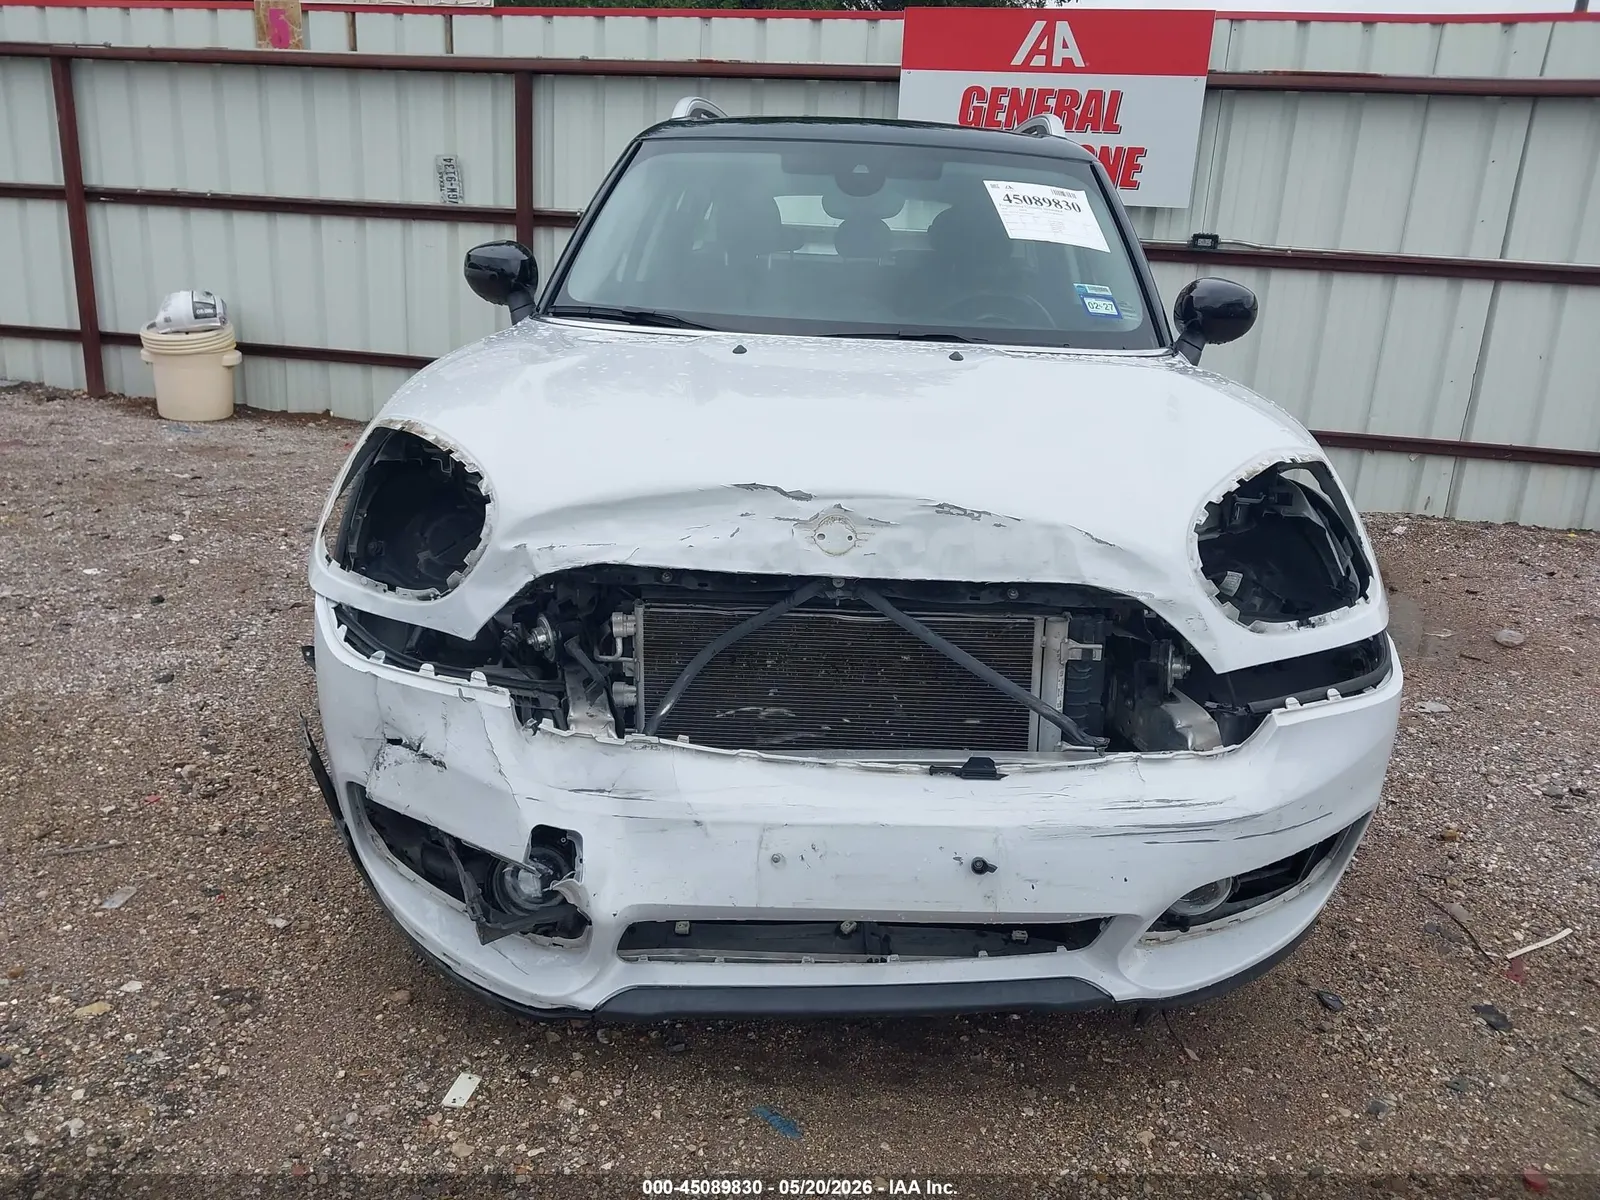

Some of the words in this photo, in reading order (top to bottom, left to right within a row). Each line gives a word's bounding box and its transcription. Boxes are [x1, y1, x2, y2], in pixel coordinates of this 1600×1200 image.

[958, 85, 1123, 134] GENERAL
[1081, 144, 1148, 190] NE
[1002, 193, 1082, 213] 45089830
